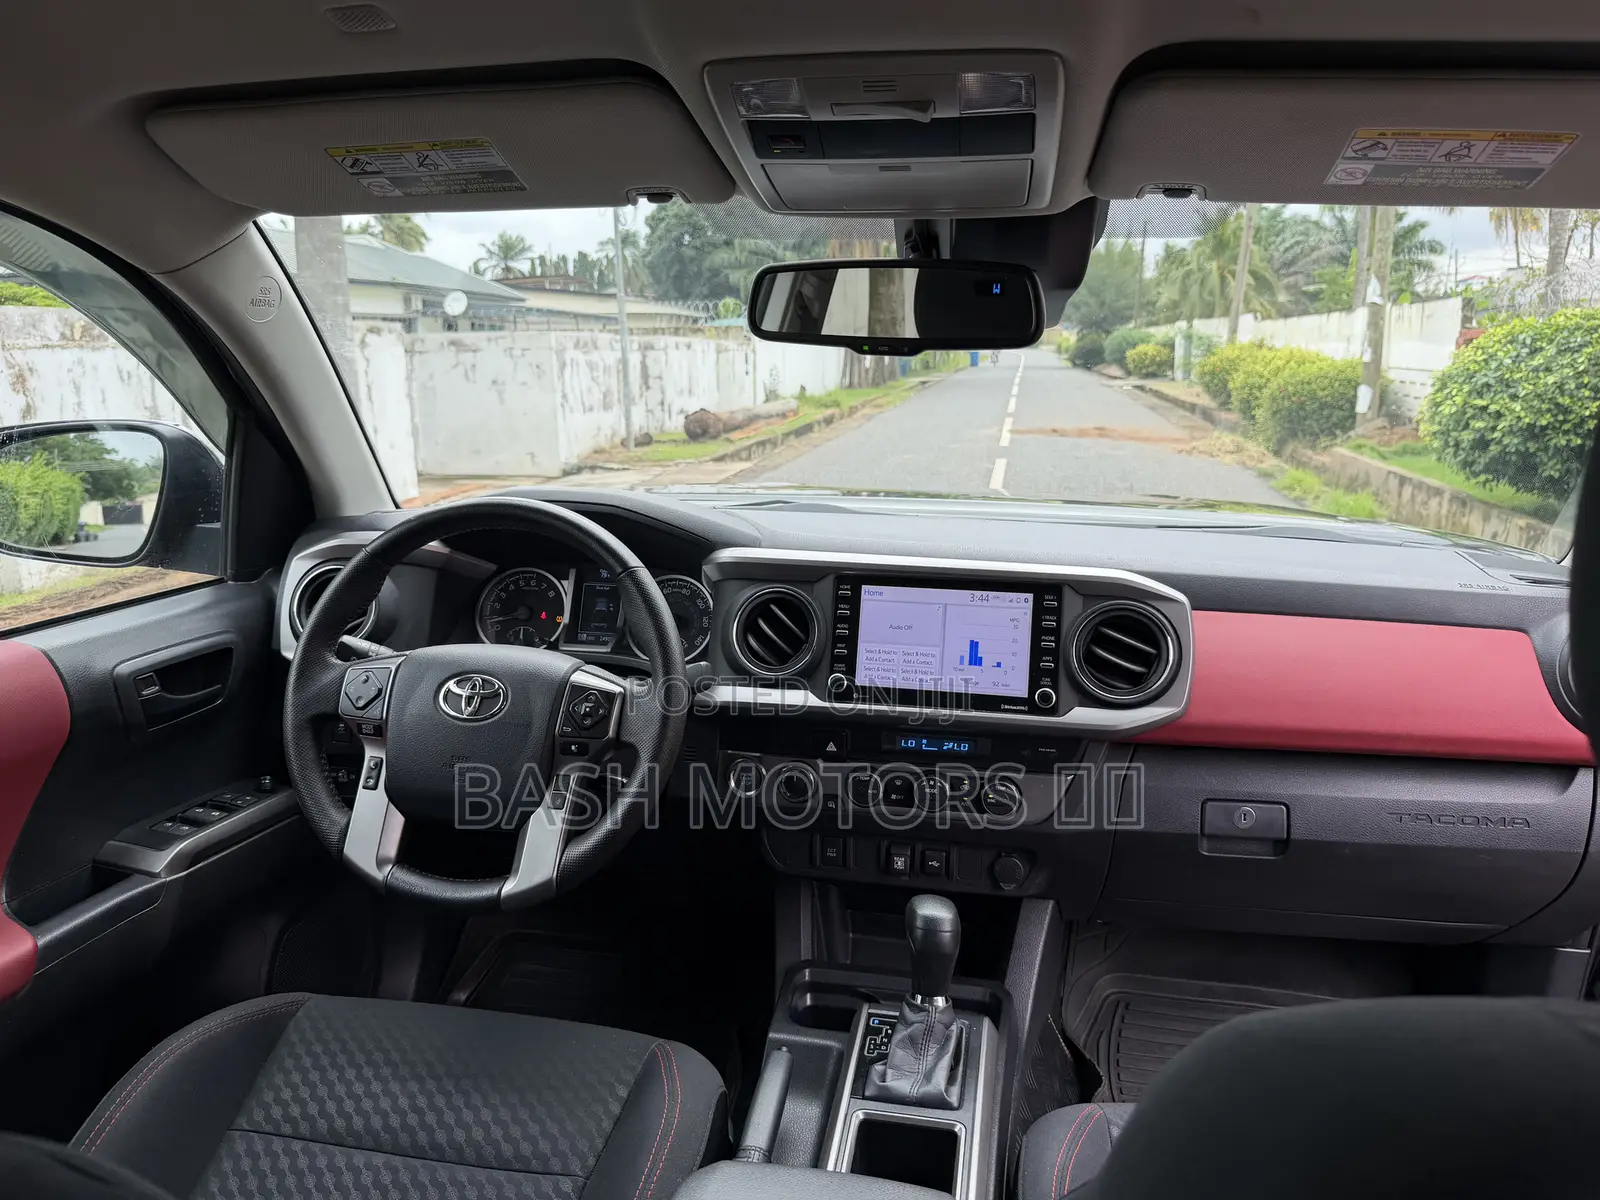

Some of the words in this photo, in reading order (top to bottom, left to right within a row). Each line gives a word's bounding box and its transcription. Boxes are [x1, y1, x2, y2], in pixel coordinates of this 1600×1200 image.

[993, 283, 1000, 294] W
[249, 298, 275, 308] AIRBAG
[864, 589, 884, 597] Home
[969, 593, 989, 603] 3:44
[1387, 812, 1530, 829] TACOMA
